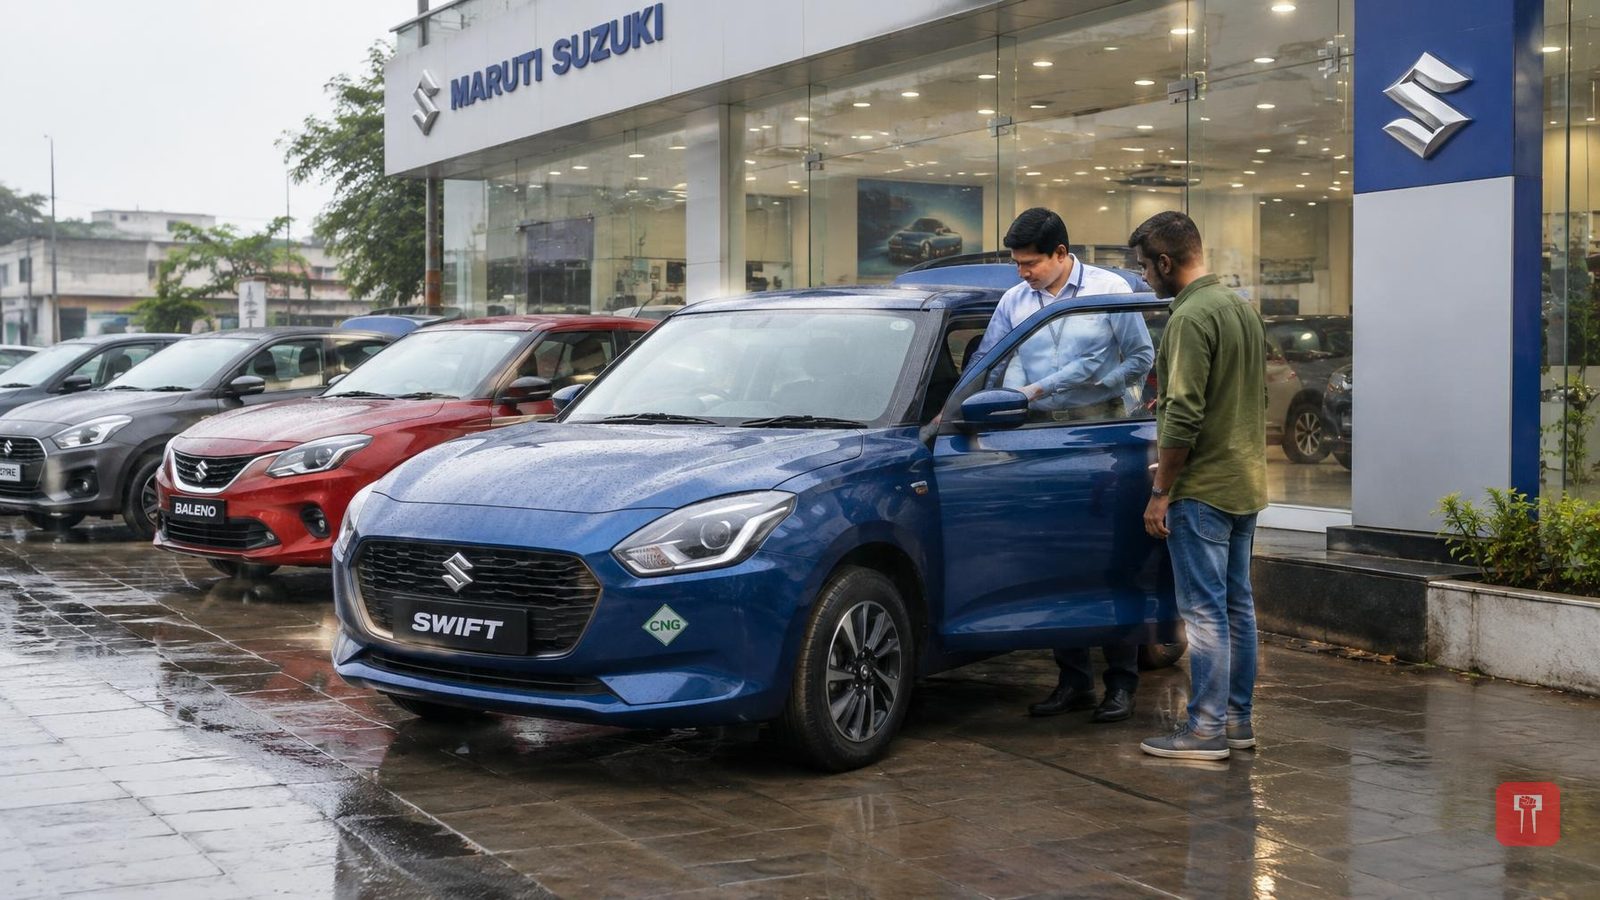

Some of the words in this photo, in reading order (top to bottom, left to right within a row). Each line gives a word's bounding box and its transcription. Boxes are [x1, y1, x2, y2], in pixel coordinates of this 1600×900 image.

[450, 48, 543, 110] MARUTI
[552, 2, 664, 75] SUZUKI
[175, 502, 216, 517] BALENO
[411, 612, 504, 640] SWIFT
[650, 619, 681, 631] CNG
